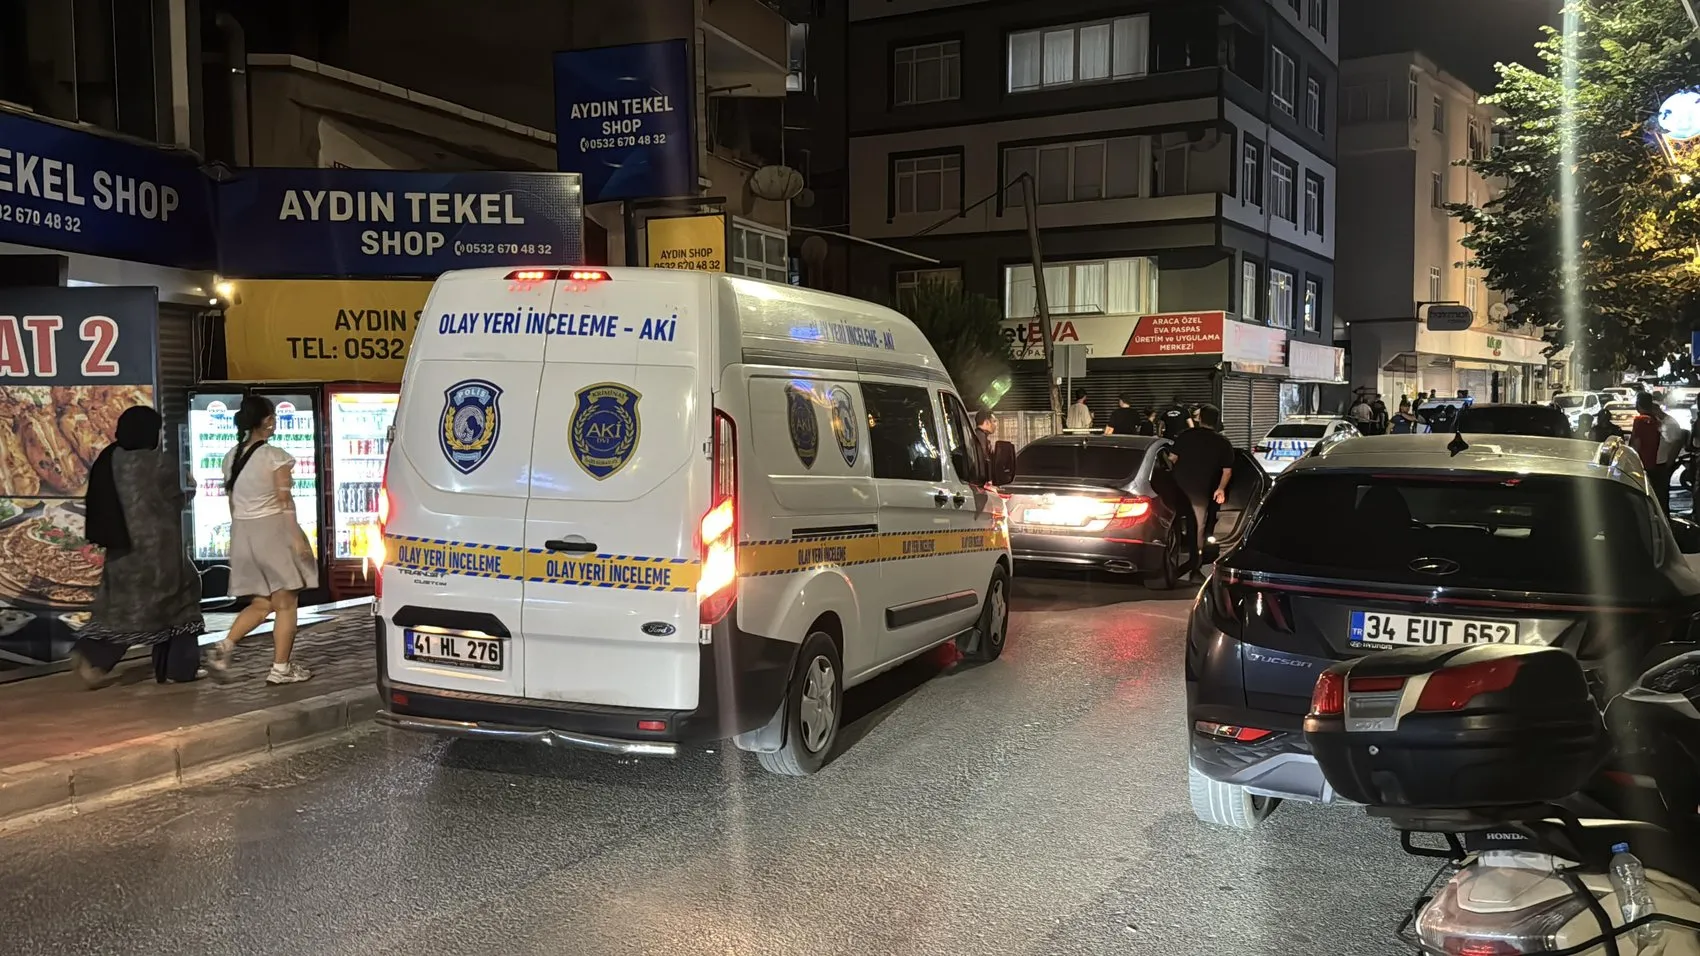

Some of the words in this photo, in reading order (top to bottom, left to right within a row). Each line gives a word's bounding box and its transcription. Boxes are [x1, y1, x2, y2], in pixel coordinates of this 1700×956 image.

[571, 100, 619, 119] AYDIN
[622, 96, 673, 115] TEKEL
[602, 119, 642, 135] SHOP
[590, 138, 615, 149] 0532
[617, 136, 635, 147] 670
[638, 135, 651, 145] 48
[653, 134, 666, 144] 32
[93, 170, 180, 222] SHOP
[279, 190, 394, 222] AYDIN
[405, 192, 524, 224] TEKEL
[15, 207, 40, 225] 670
[44, 212, 61, 229] 48
[64, 216, 81, 233] 32
[361, 231, 445, 256] SHOP
[466, 243, 495, 254] 0532
[497, 243, 518, 254] 670
[520, 244, 535, 254] 48
[537, 244, 552, 255] 32
[661, 248, 687, 259] AYDIN
[689, 247, 713, 258] SHOP
[696, 260, 708, 270] 48
[709, 259, 721, 270] 32
[335, 309, 407, 332] AYDIN
[439, 313, 480, 335] OLAY
[483, 306, 522, 334] YERİ
[525, 306, 619, 338] İNCELEME
[639, 314, 678, 342] AKİ
[1152, 317, 1180, 325] ARACA
[1181, 316, 1203, 324] ÖZEL
[79, 315, 120, 377] 2
[287, 337, 338, 359] TEL:
[345, 337, 405, 360] 0532
[1160, 343, 1194, 351] MERKEZİ
[1176, 334, 1220, 342] UYGULAMA
[459, 389, 486, 398] POLİS
[586, 421, 622, 438] AKİ
[398, 545, 422, 564] OLAY
[424, 546, 446, 568] YERİ
[449, 547, 502, 573] İNCELEME
[546, 560, 577, 578] OLAY
[579, 560, 605, 581] YERİ
[609, 560, 671, 585] İNCELEME
[1351, 627, 1363, 636] TR
[1366, 615, 1396, 641] 34
[1407, 618, 1453, 645] EUT
[415, 635, 431, 654] 41
[440, 638, 460, 658] HL
[467, 640, 499, 662] 276
